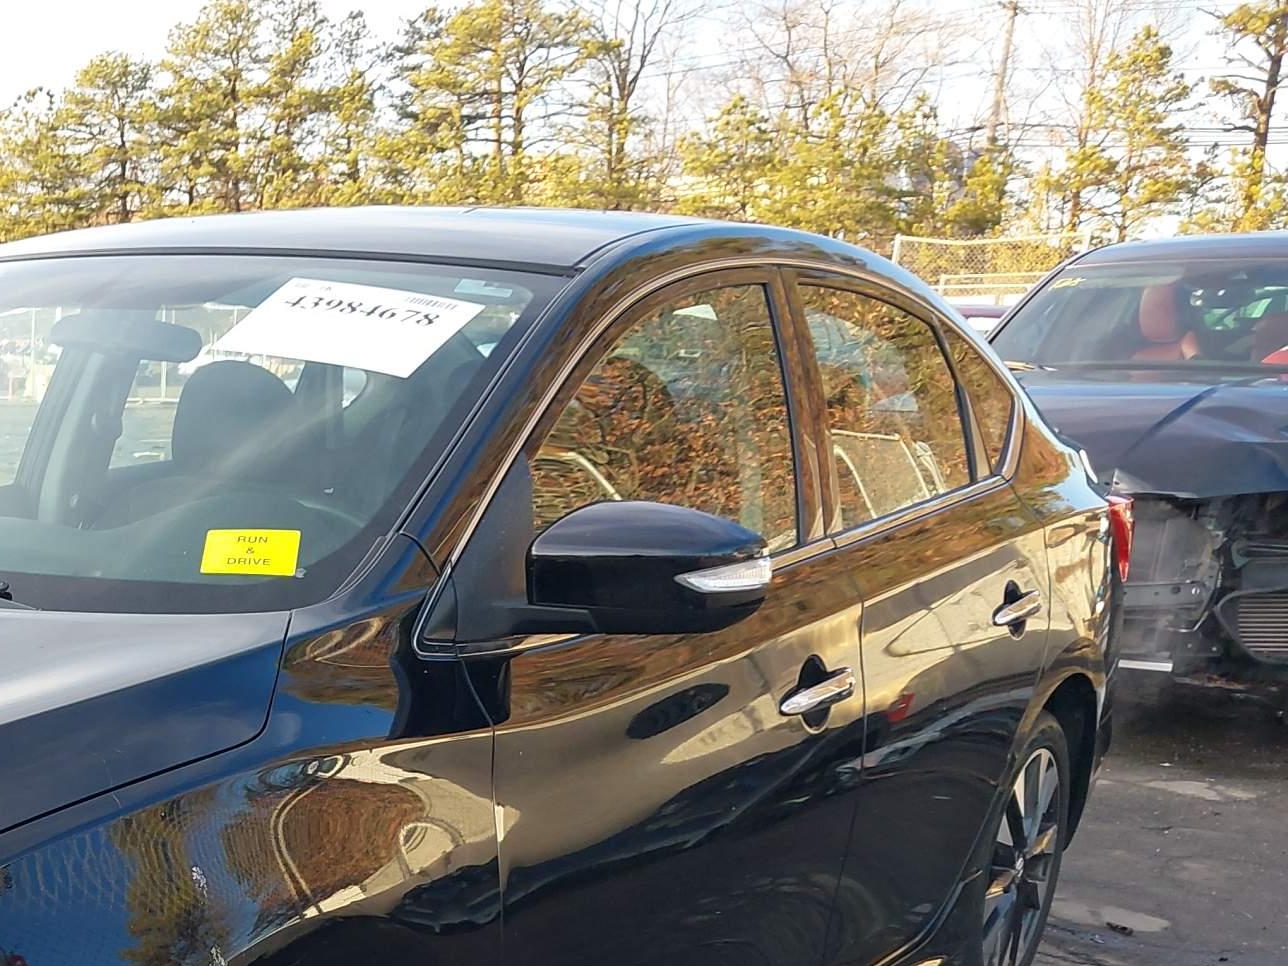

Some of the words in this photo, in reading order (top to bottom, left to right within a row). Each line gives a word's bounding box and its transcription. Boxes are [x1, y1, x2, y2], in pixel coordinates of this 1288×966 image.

[285, 295, 440, 326] 43984678
[237, 536, 268, 544] RUN
[227, 557, 271, 566] DRIVE
